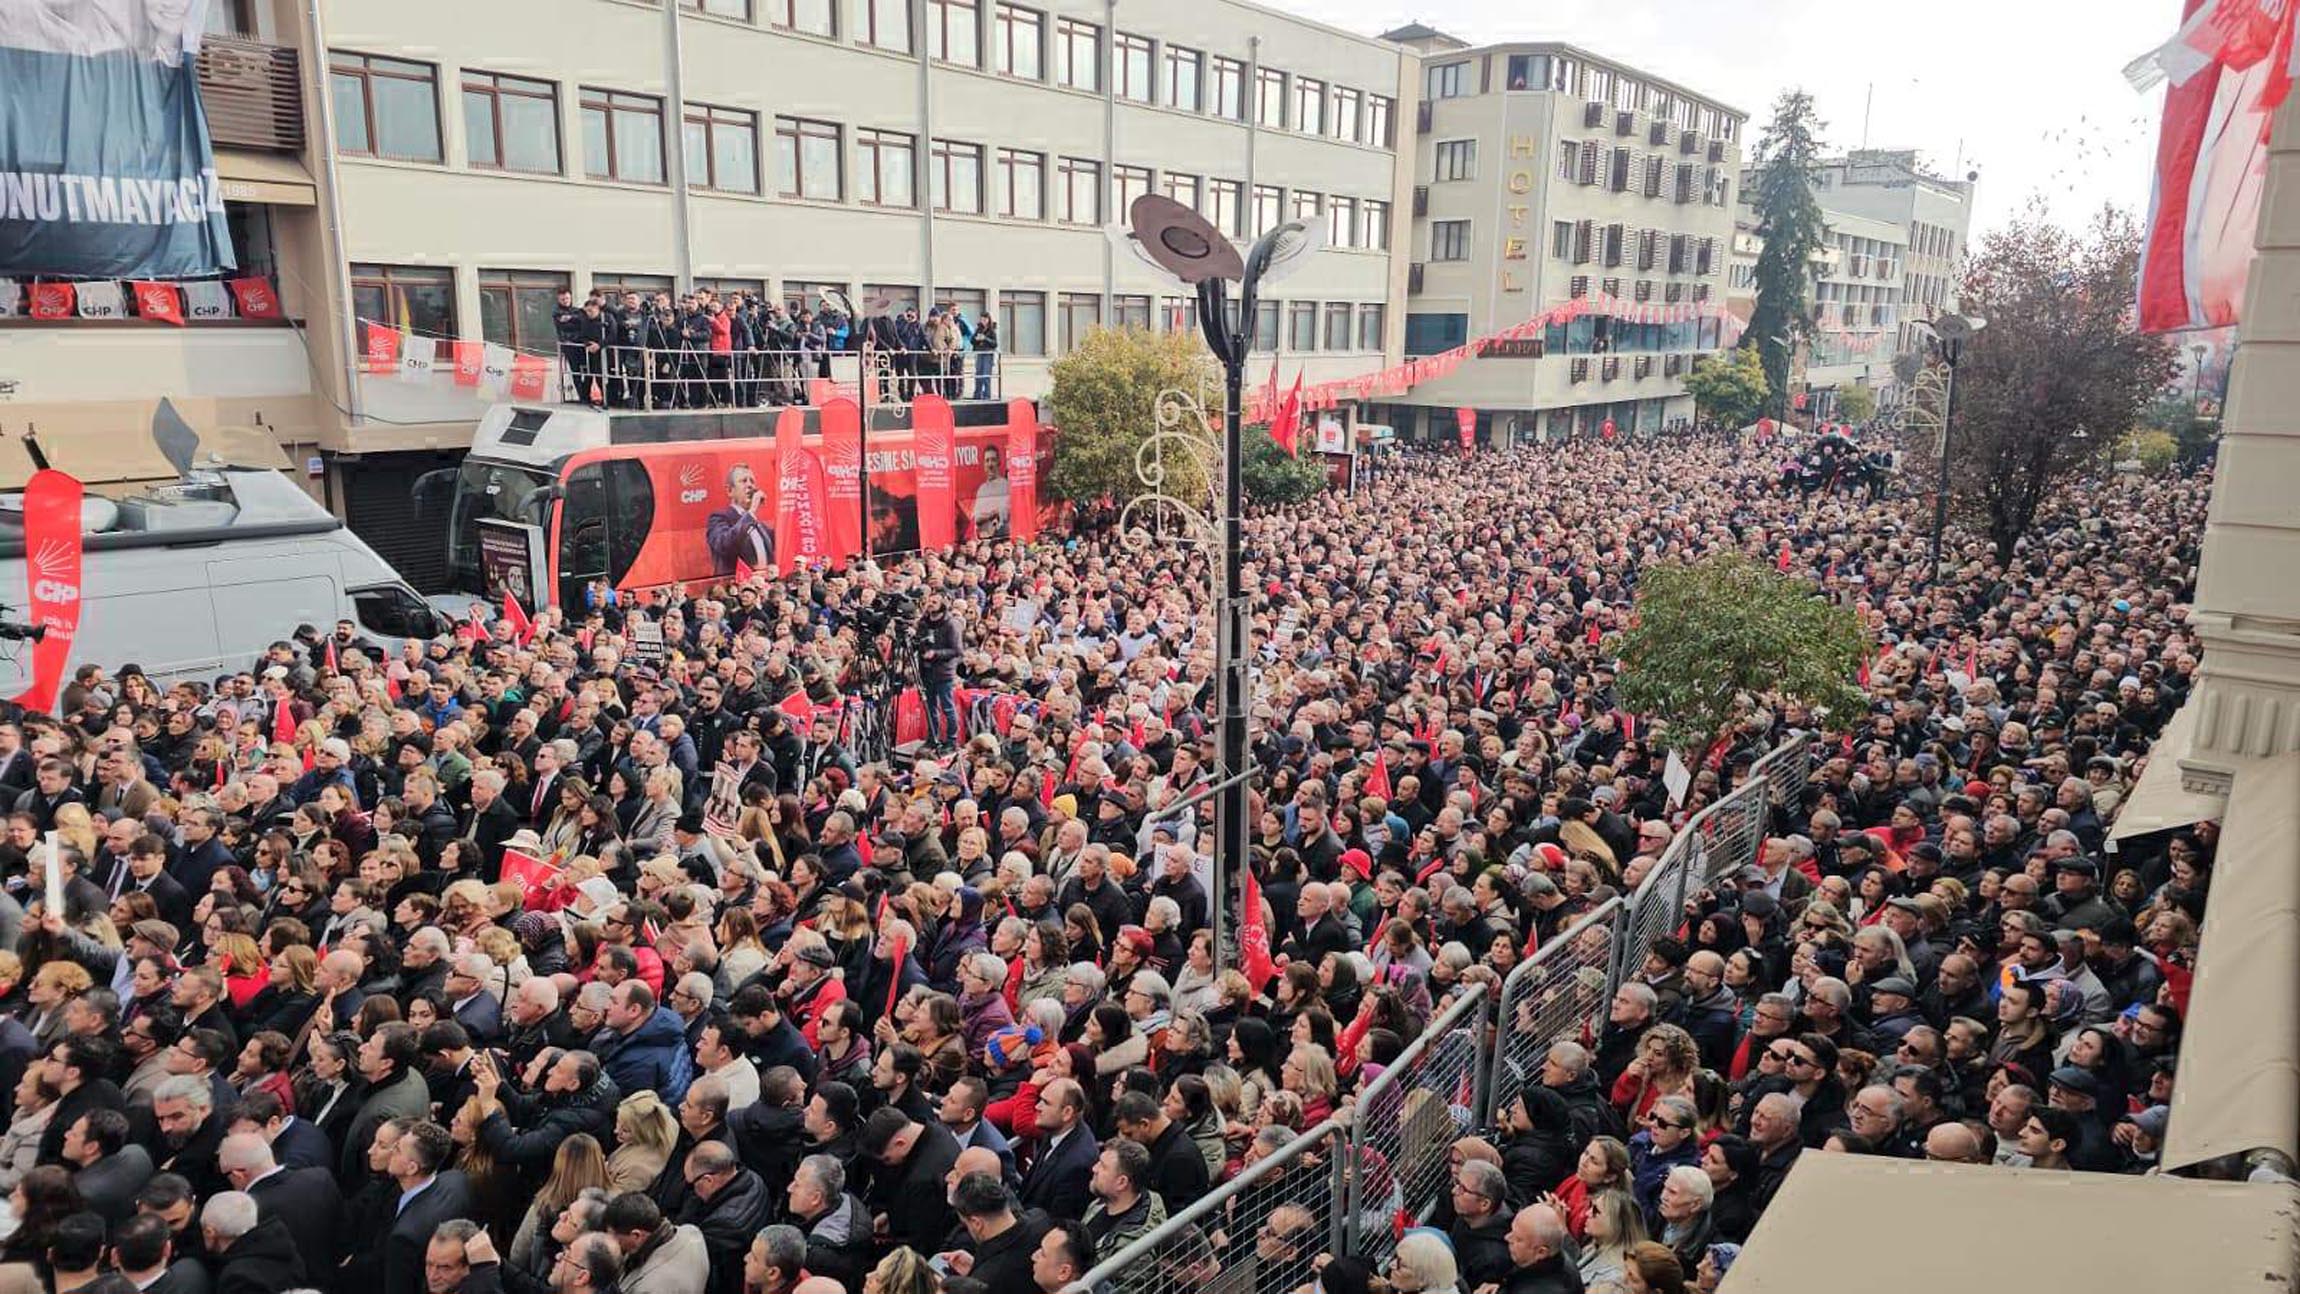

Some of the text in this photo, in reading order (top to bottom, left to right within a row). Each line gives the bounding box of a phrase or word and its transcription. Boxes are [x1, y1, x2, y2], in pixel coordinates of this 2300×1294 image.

[1502, 134, 1534, 292] HOTEL
[83, 305, 111, 317] CHP
[194, 305, 220, 317] CHP
[246, 301, 269, 313] CHP
[680, 489, 707, 504] CHP
